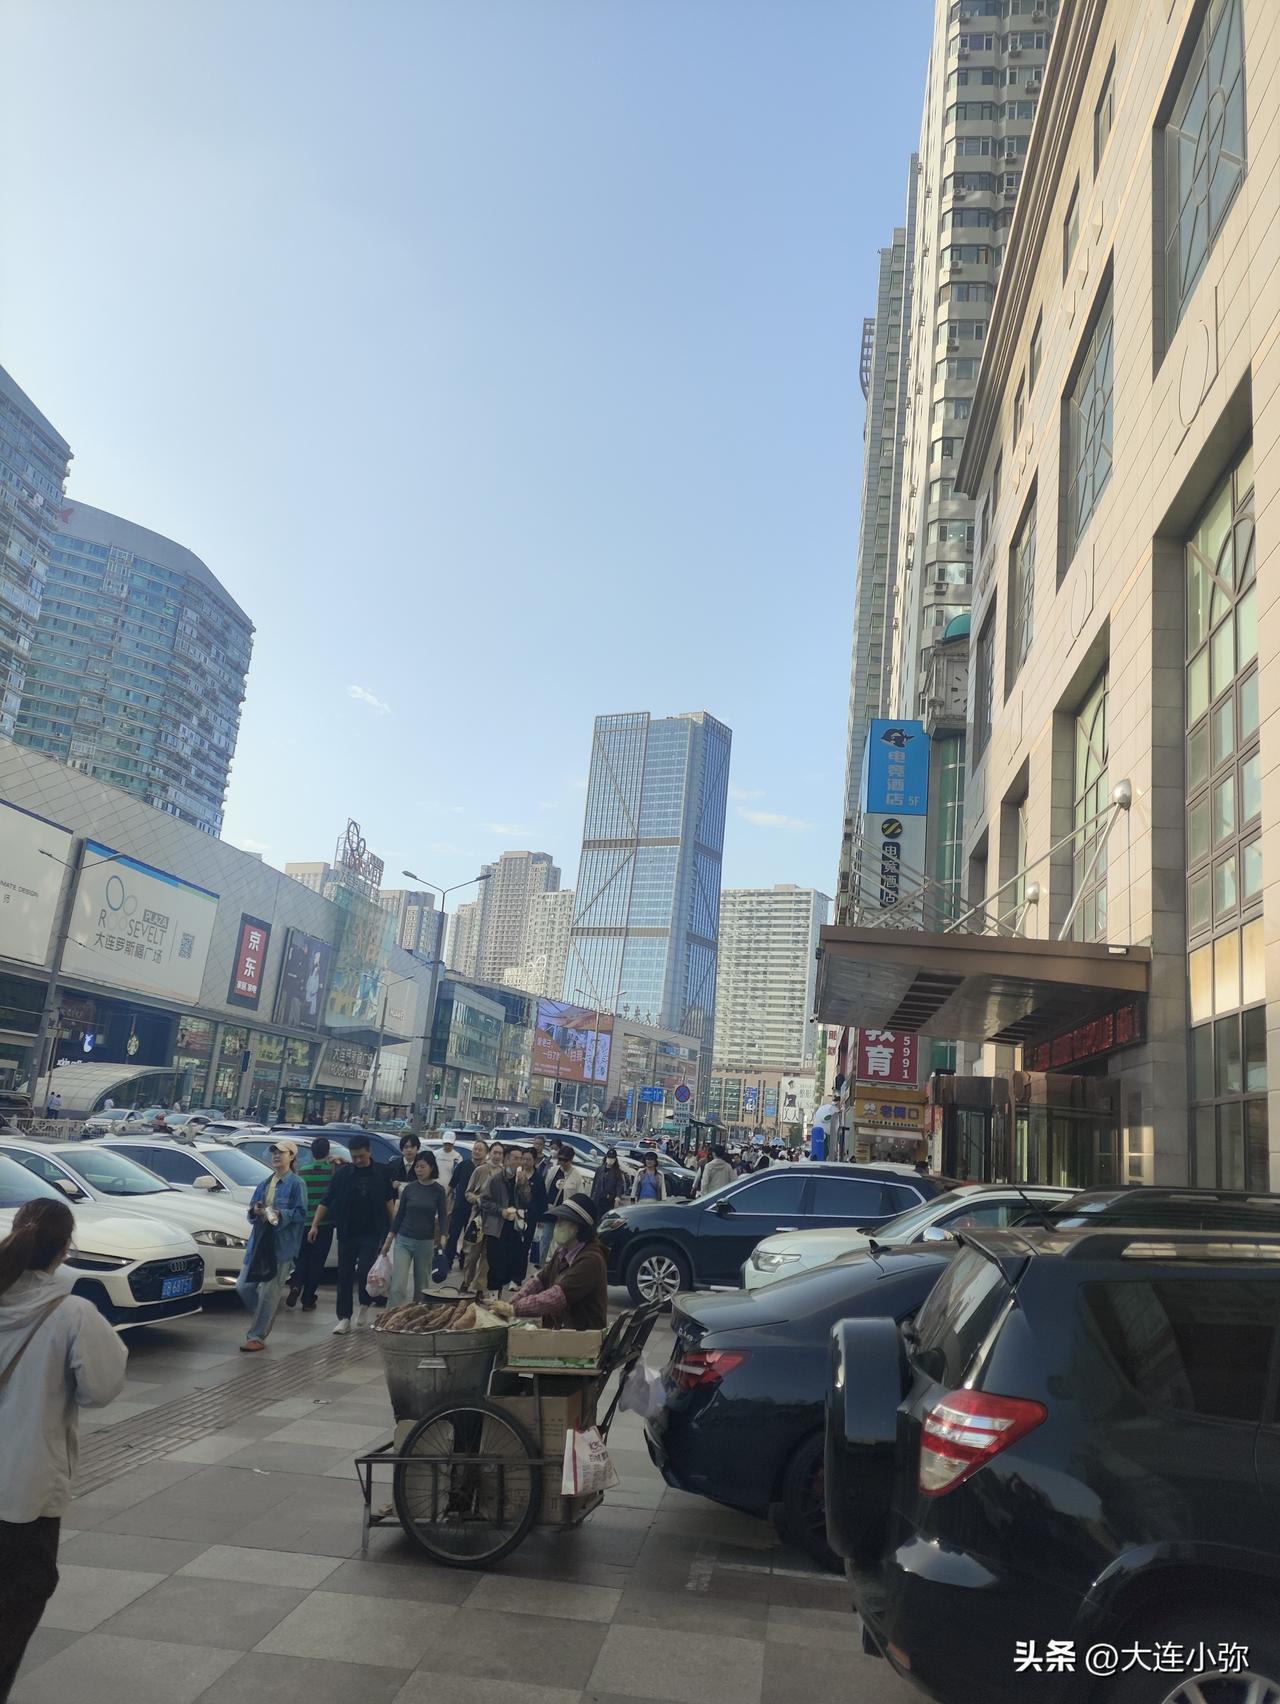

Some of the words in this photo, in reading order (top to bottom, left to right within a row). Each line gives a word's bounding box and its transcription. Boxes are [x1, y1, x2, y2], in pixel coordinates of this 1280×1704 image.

[886, 750, 905, 806] 电竞酒店
[908, 796, 920, 807] 5F
[94, 932, 163, 964] 大连罗斯福广场
[243, 931, 261, 978] 京东
